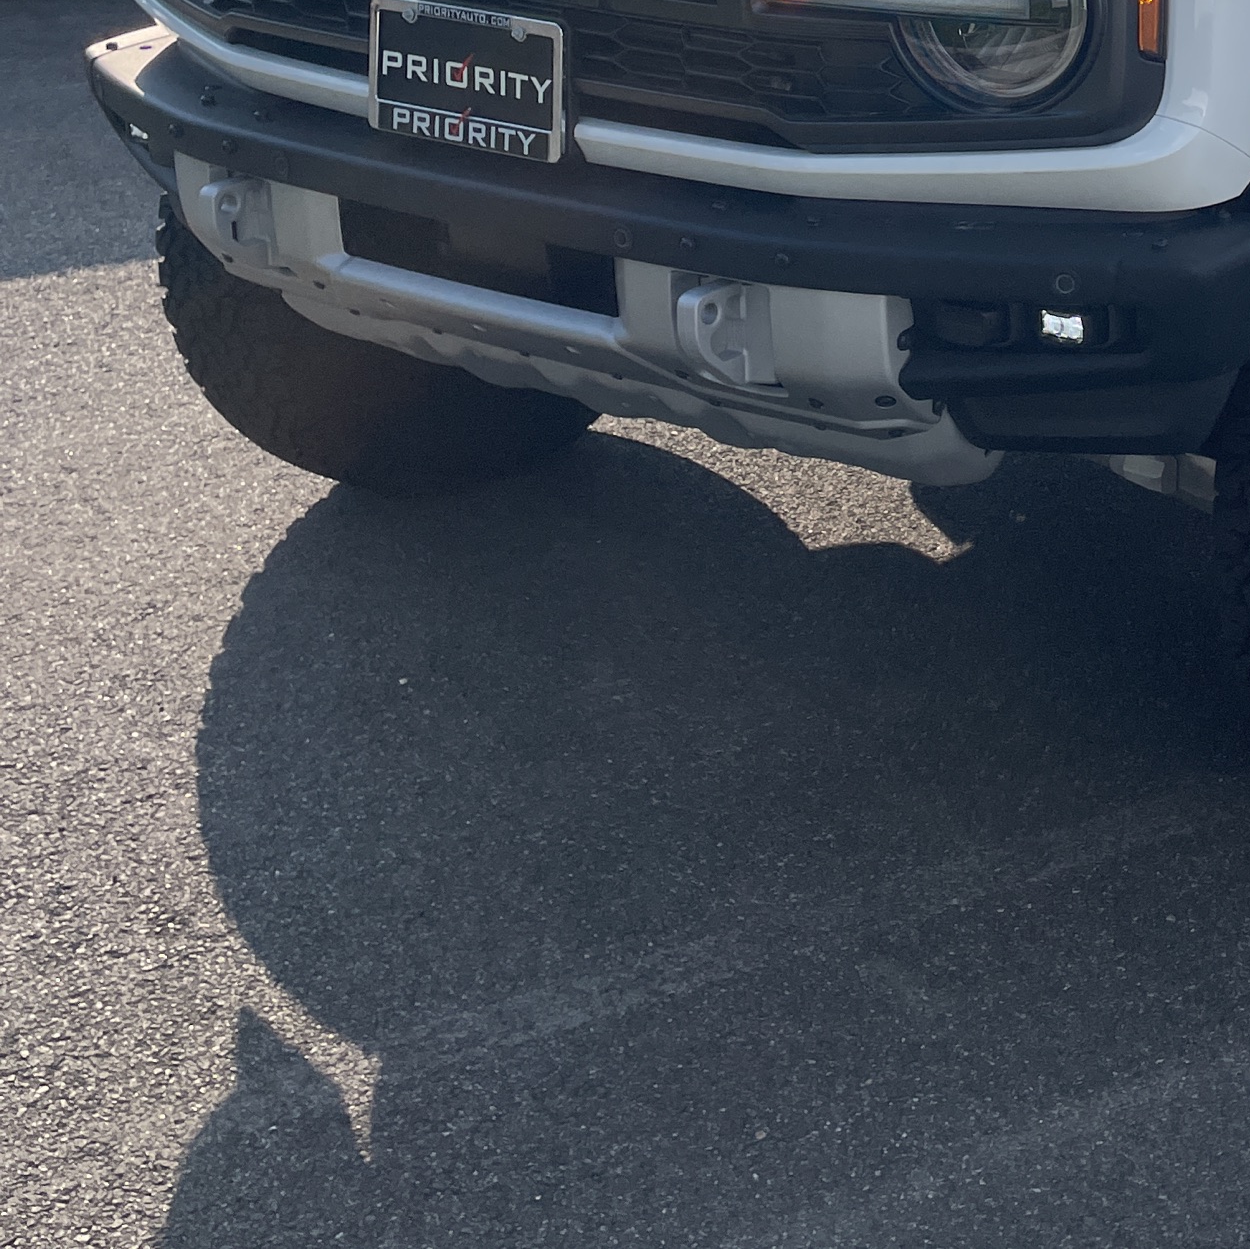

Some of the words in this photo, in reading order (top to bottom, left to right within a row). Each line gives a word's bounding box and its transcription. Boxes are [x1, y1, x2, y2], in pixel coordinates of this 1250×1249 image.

[417, 4, 511, 28] PRIORITYAUTO.COM
[382, 49, 552, 105] PRIORITY
[392, 106, 537, 156] PRIORITY
